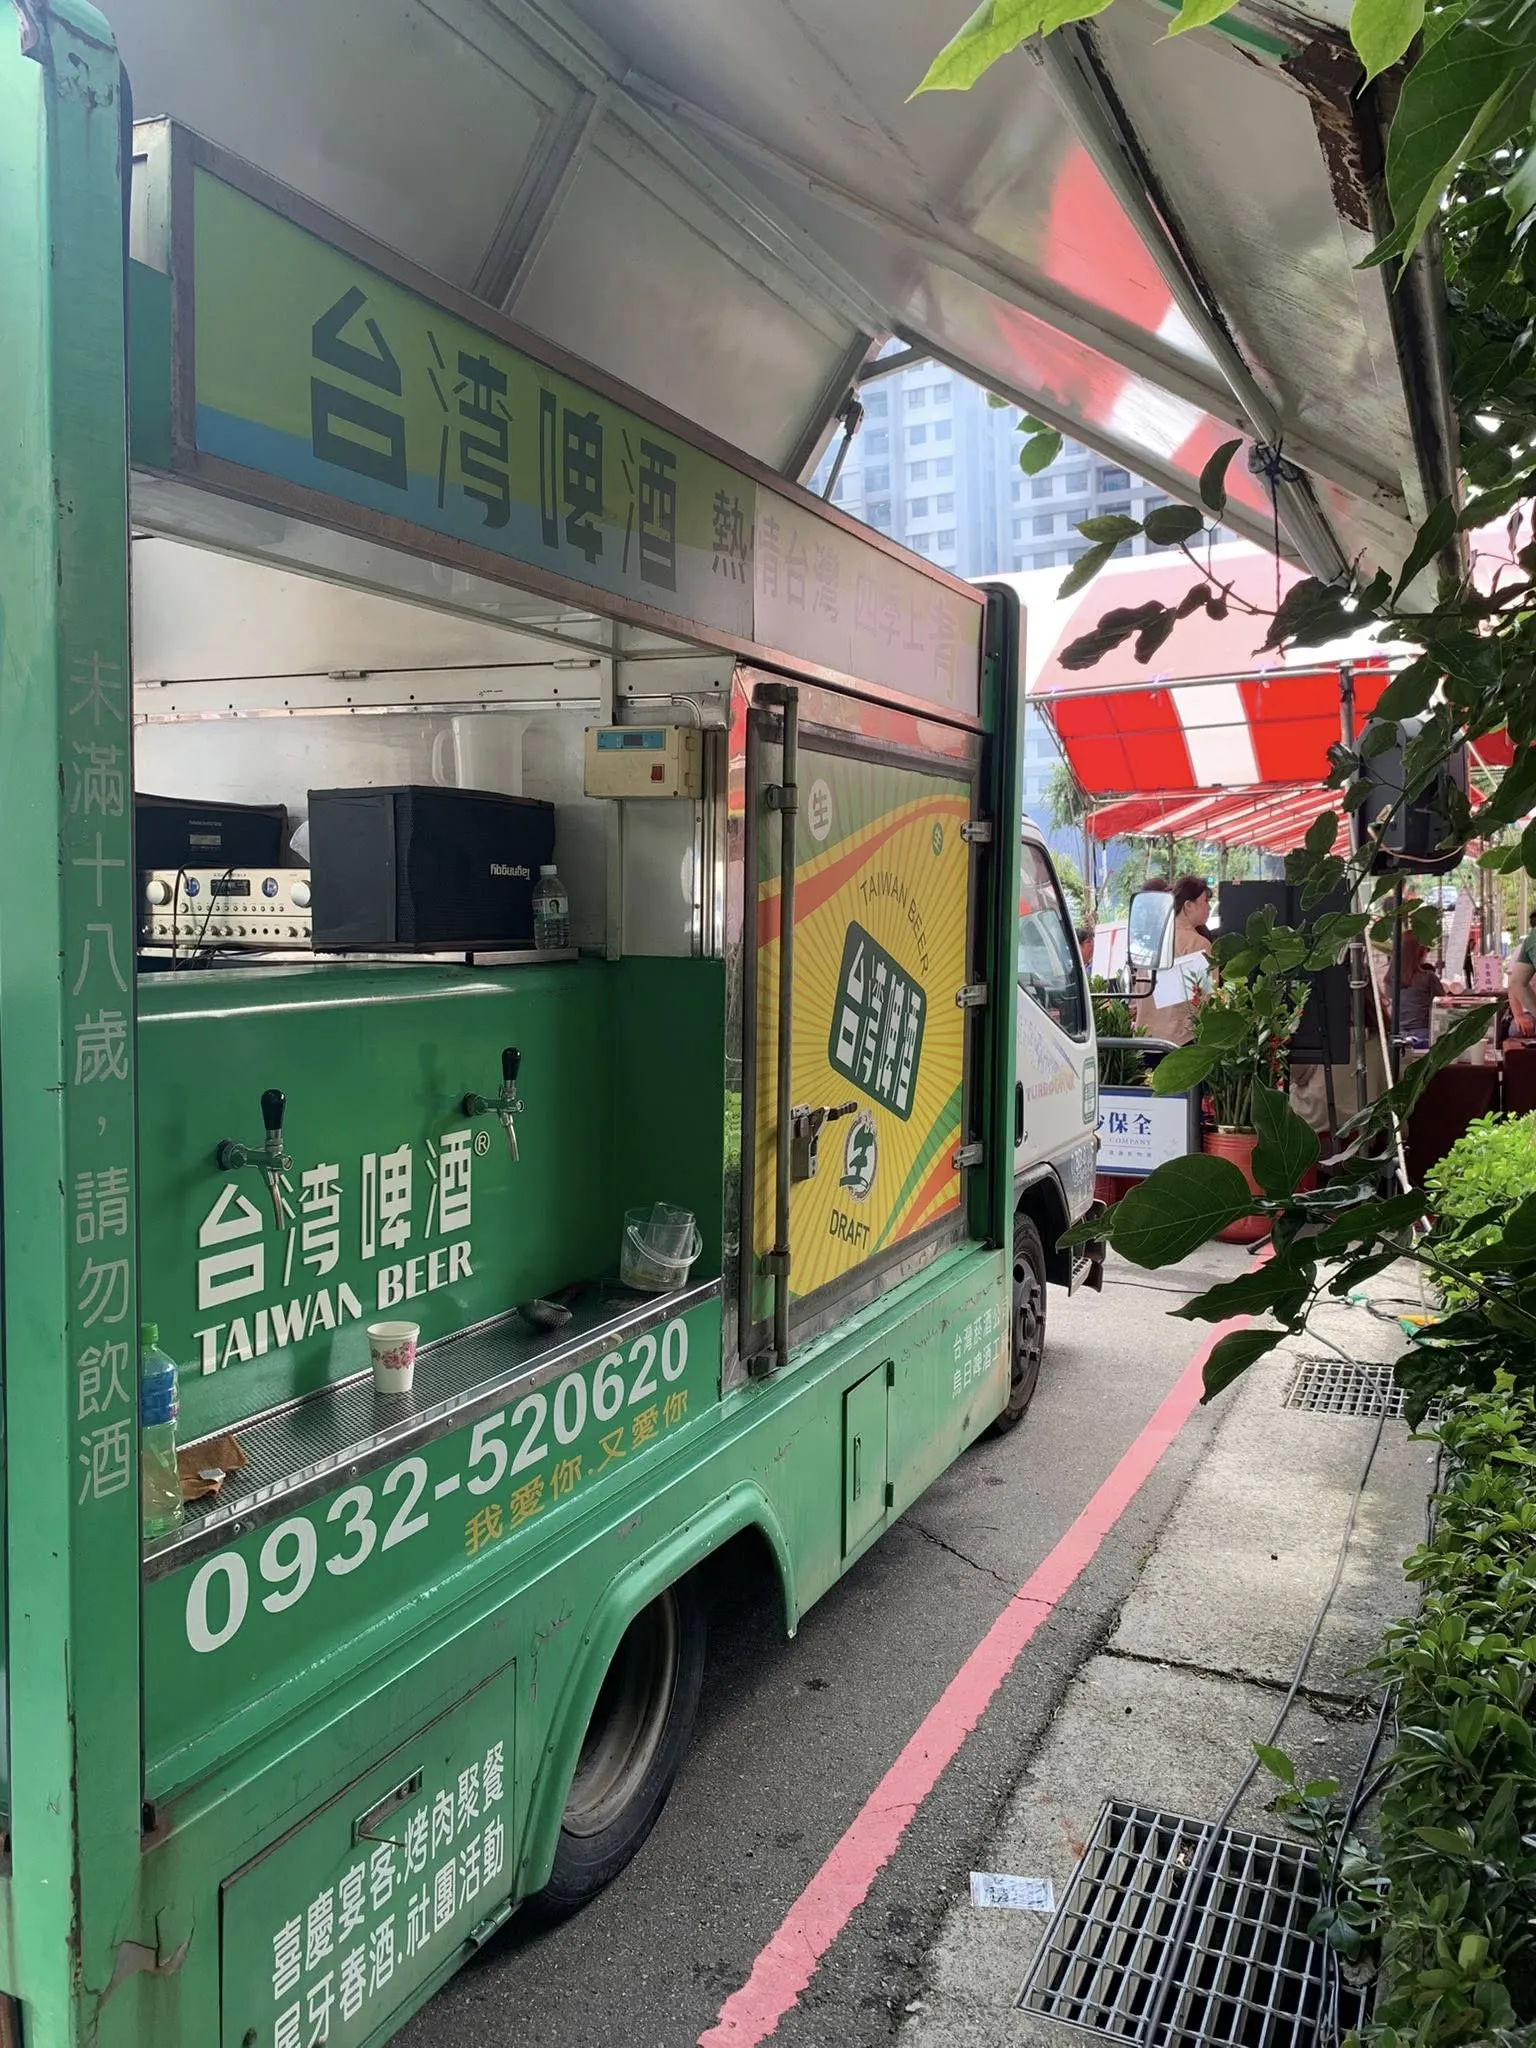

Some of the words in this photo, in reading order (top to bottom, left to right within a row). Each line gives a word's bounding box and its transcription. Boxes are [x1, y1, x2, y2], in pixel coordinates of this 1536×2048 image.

[311, 285, 677, 593] 台灣啤酒
[859, 871, 908, 909] TAIWAN
[907, 898, 930, 977] BEER
[836, 940, 922, 1111] 台灣啤酒
[1109, 1137, 1152, 1146] COMPANY
[828, 1208, 871, 1251] DRAFT
[193, 1282, 363, 1377] TAIWAN
[377, 1240, 474, 1311] BEER
[185, 1317, 690, 1654] 0932-520620
